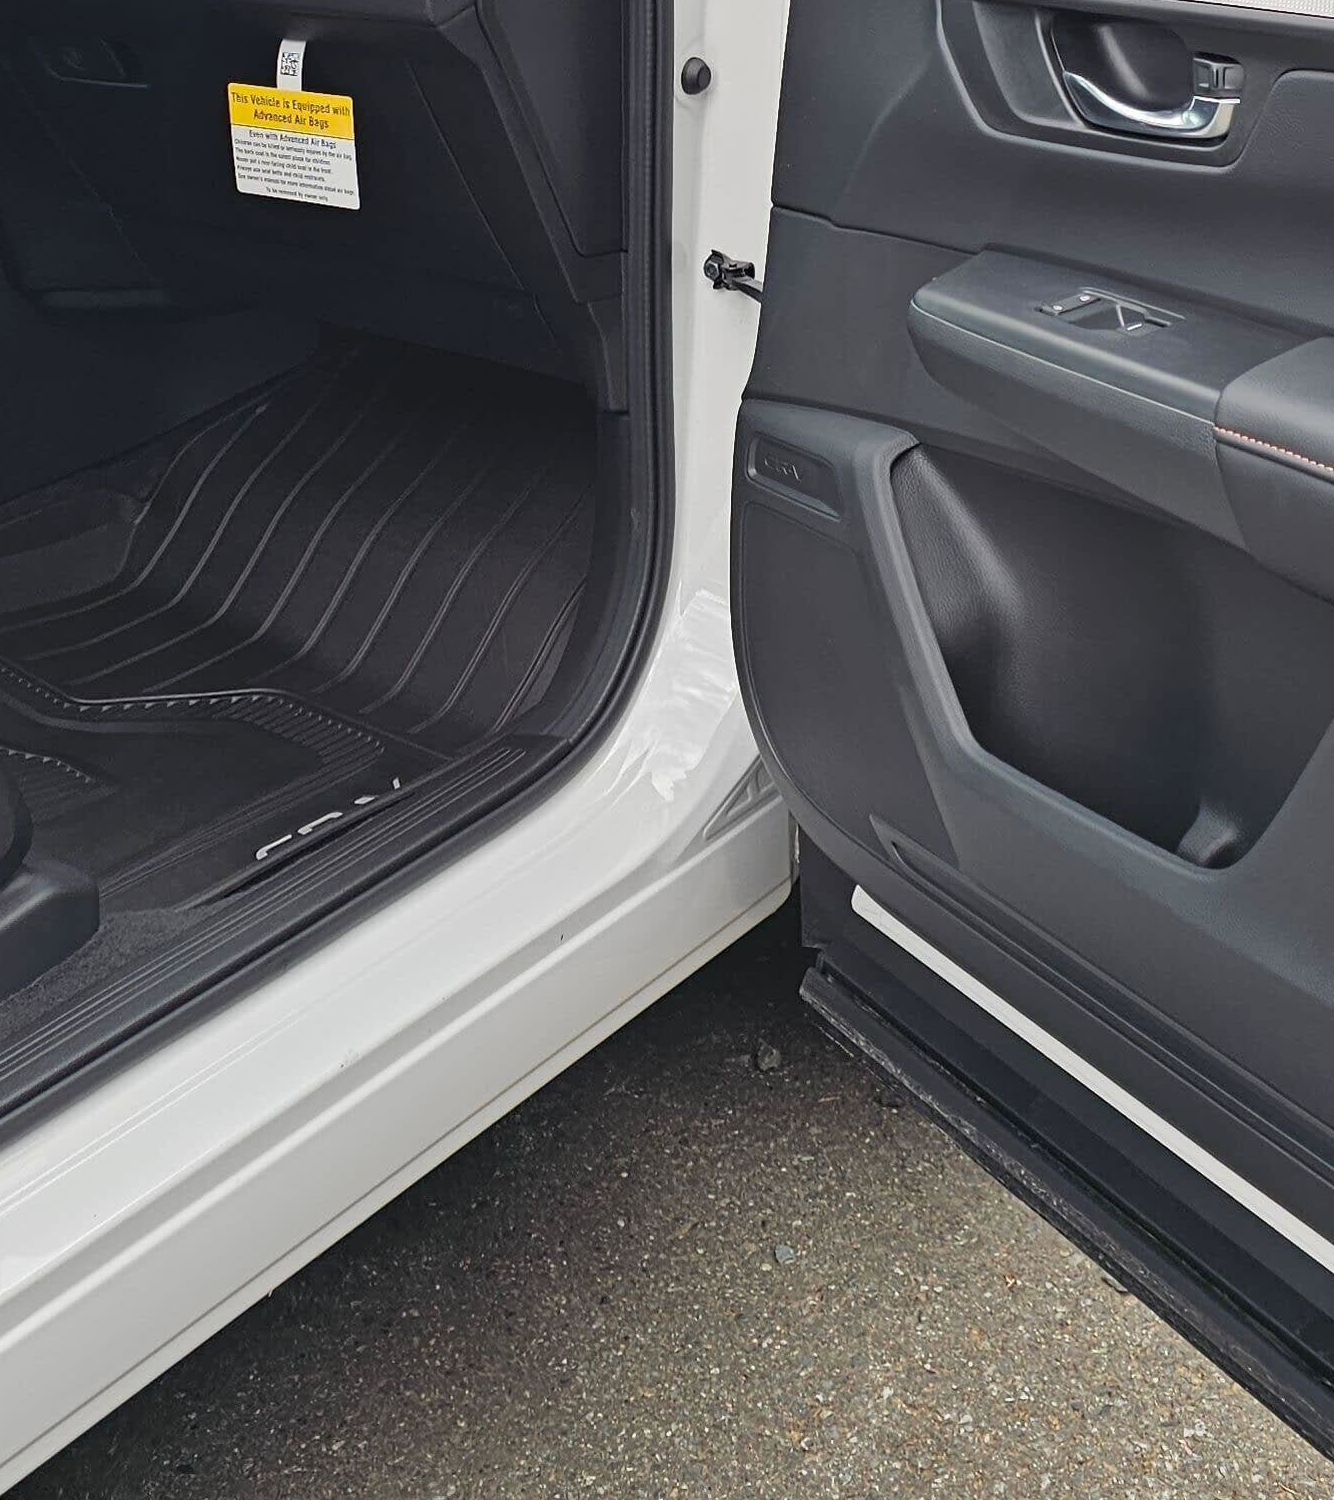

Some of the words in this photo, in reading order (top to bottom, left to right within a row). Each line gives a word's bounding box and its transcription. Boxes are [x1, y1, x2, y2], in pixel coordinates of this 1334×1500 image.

[231, 92, 248, 104] This
[250, 94, 280, 108] Vehicle
[283, 97, 290, 109] is
[292, 100, 330, 115] Equipped
[332, 105, 350, 117] with
[253, 109, 292, 124] Advanced
[295, 115, 306, 126] Air
[309, 116, 330, 130] Bags
[249, 129, 264, 139] Even
[265, 131, 278, 141] with
[280, 133, 309, 145] Advanced
[311, 137, 320, 147] Air
[321, 139, 337, 150] Bags
